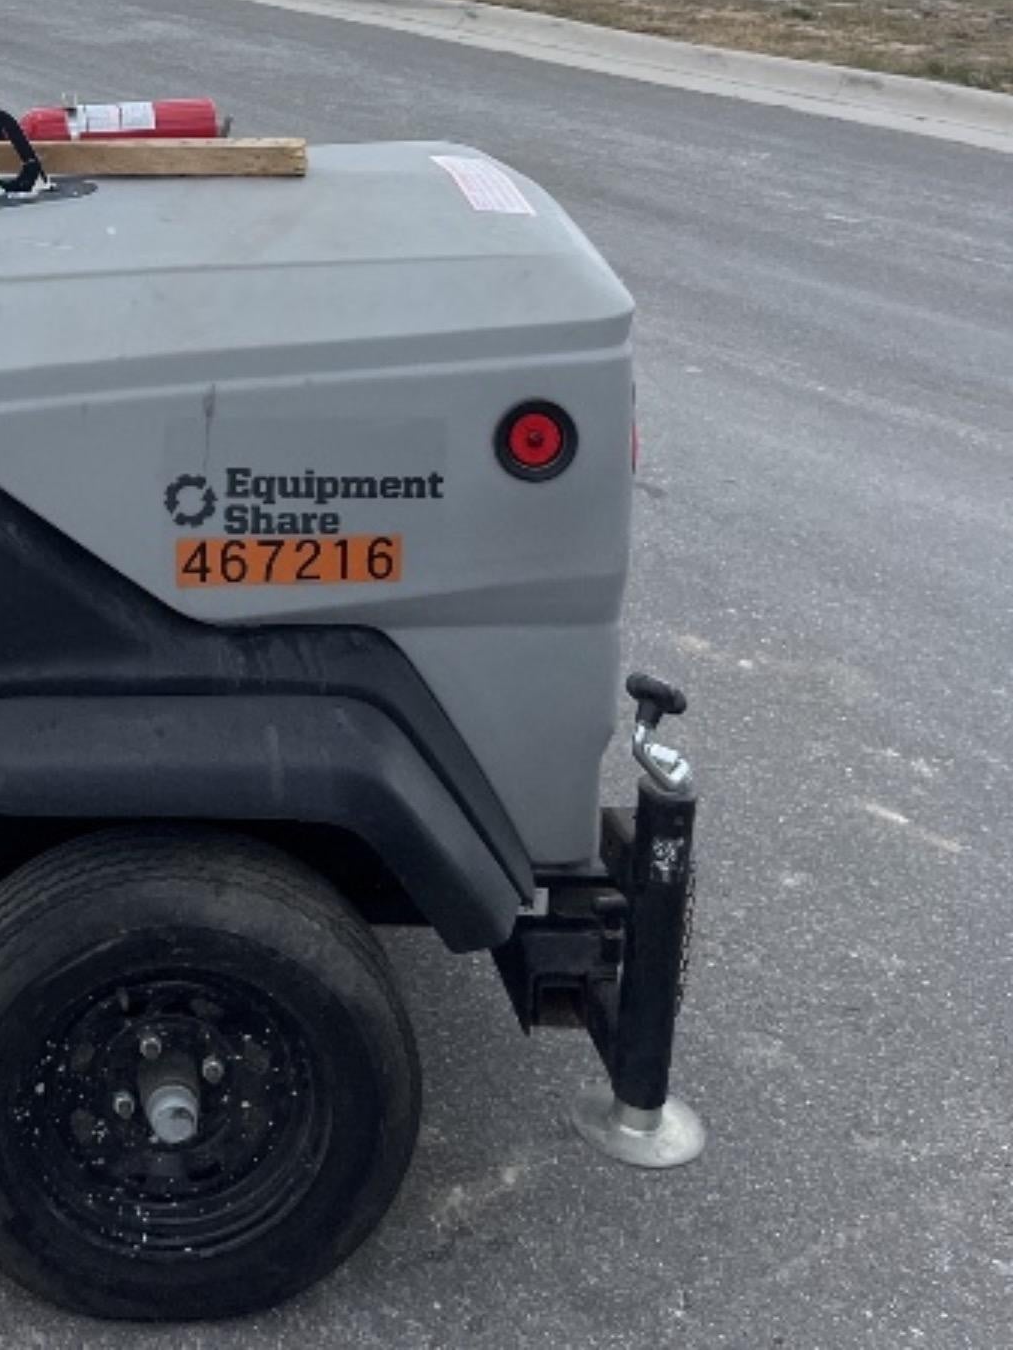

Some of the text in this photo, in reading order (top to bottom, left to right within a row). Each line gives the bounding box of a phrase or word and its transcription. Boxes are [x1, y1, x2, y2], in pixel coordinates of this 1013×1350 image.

[225, 467, 444, 504] Equipment
[223, 504, 340, 535] Share
[181, 536, 395, 583] 467216
